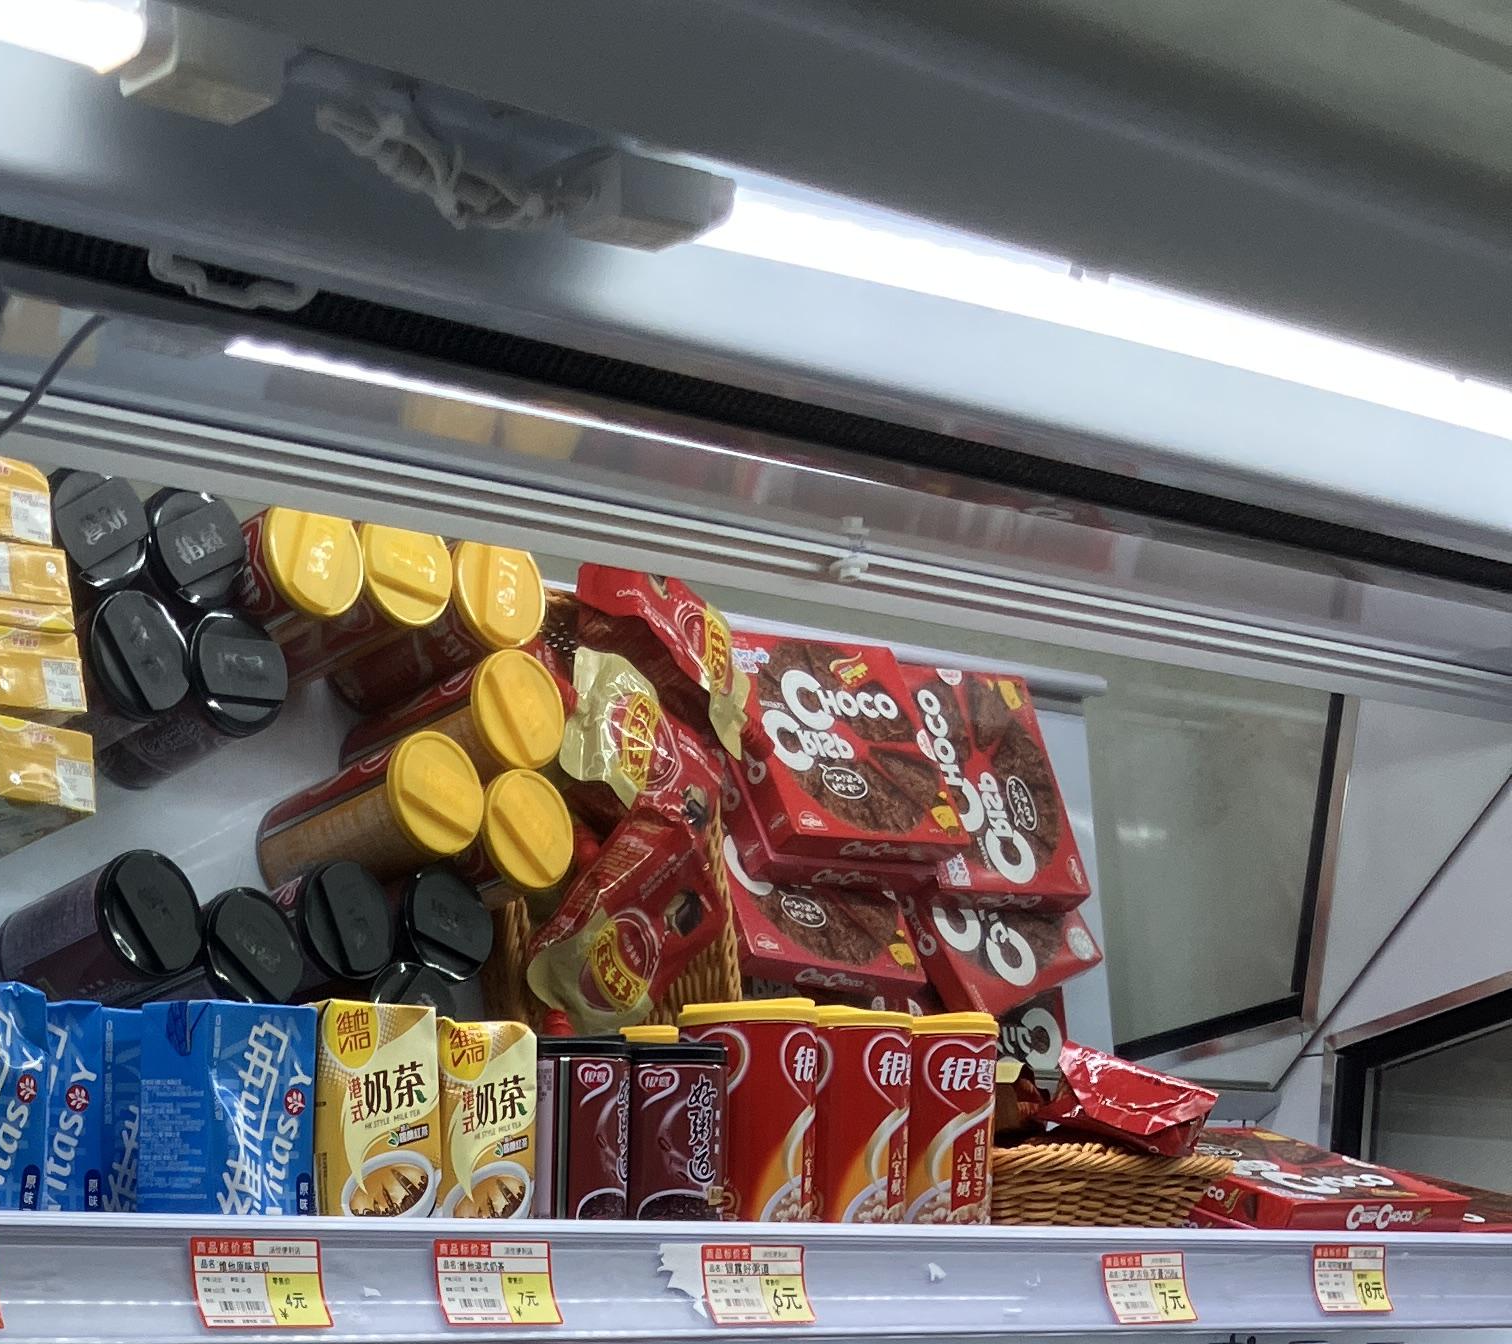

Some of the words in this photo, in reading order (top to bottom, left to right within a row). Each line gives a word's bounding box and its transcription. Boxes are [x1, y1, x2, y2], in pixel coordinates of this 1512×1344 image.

[348, 1076, 363, 1125] 港式
[362, 1061, 427, 1117] 奶茶
[462, 1089, 476, 1136] 港式
[475, 1074, 528, 1127] 奶茶
[285, 1292, 308, 1309] 4元
[517, 1291, 539, 1307] 7元
[773, 1287, 803, 1310] 6元
